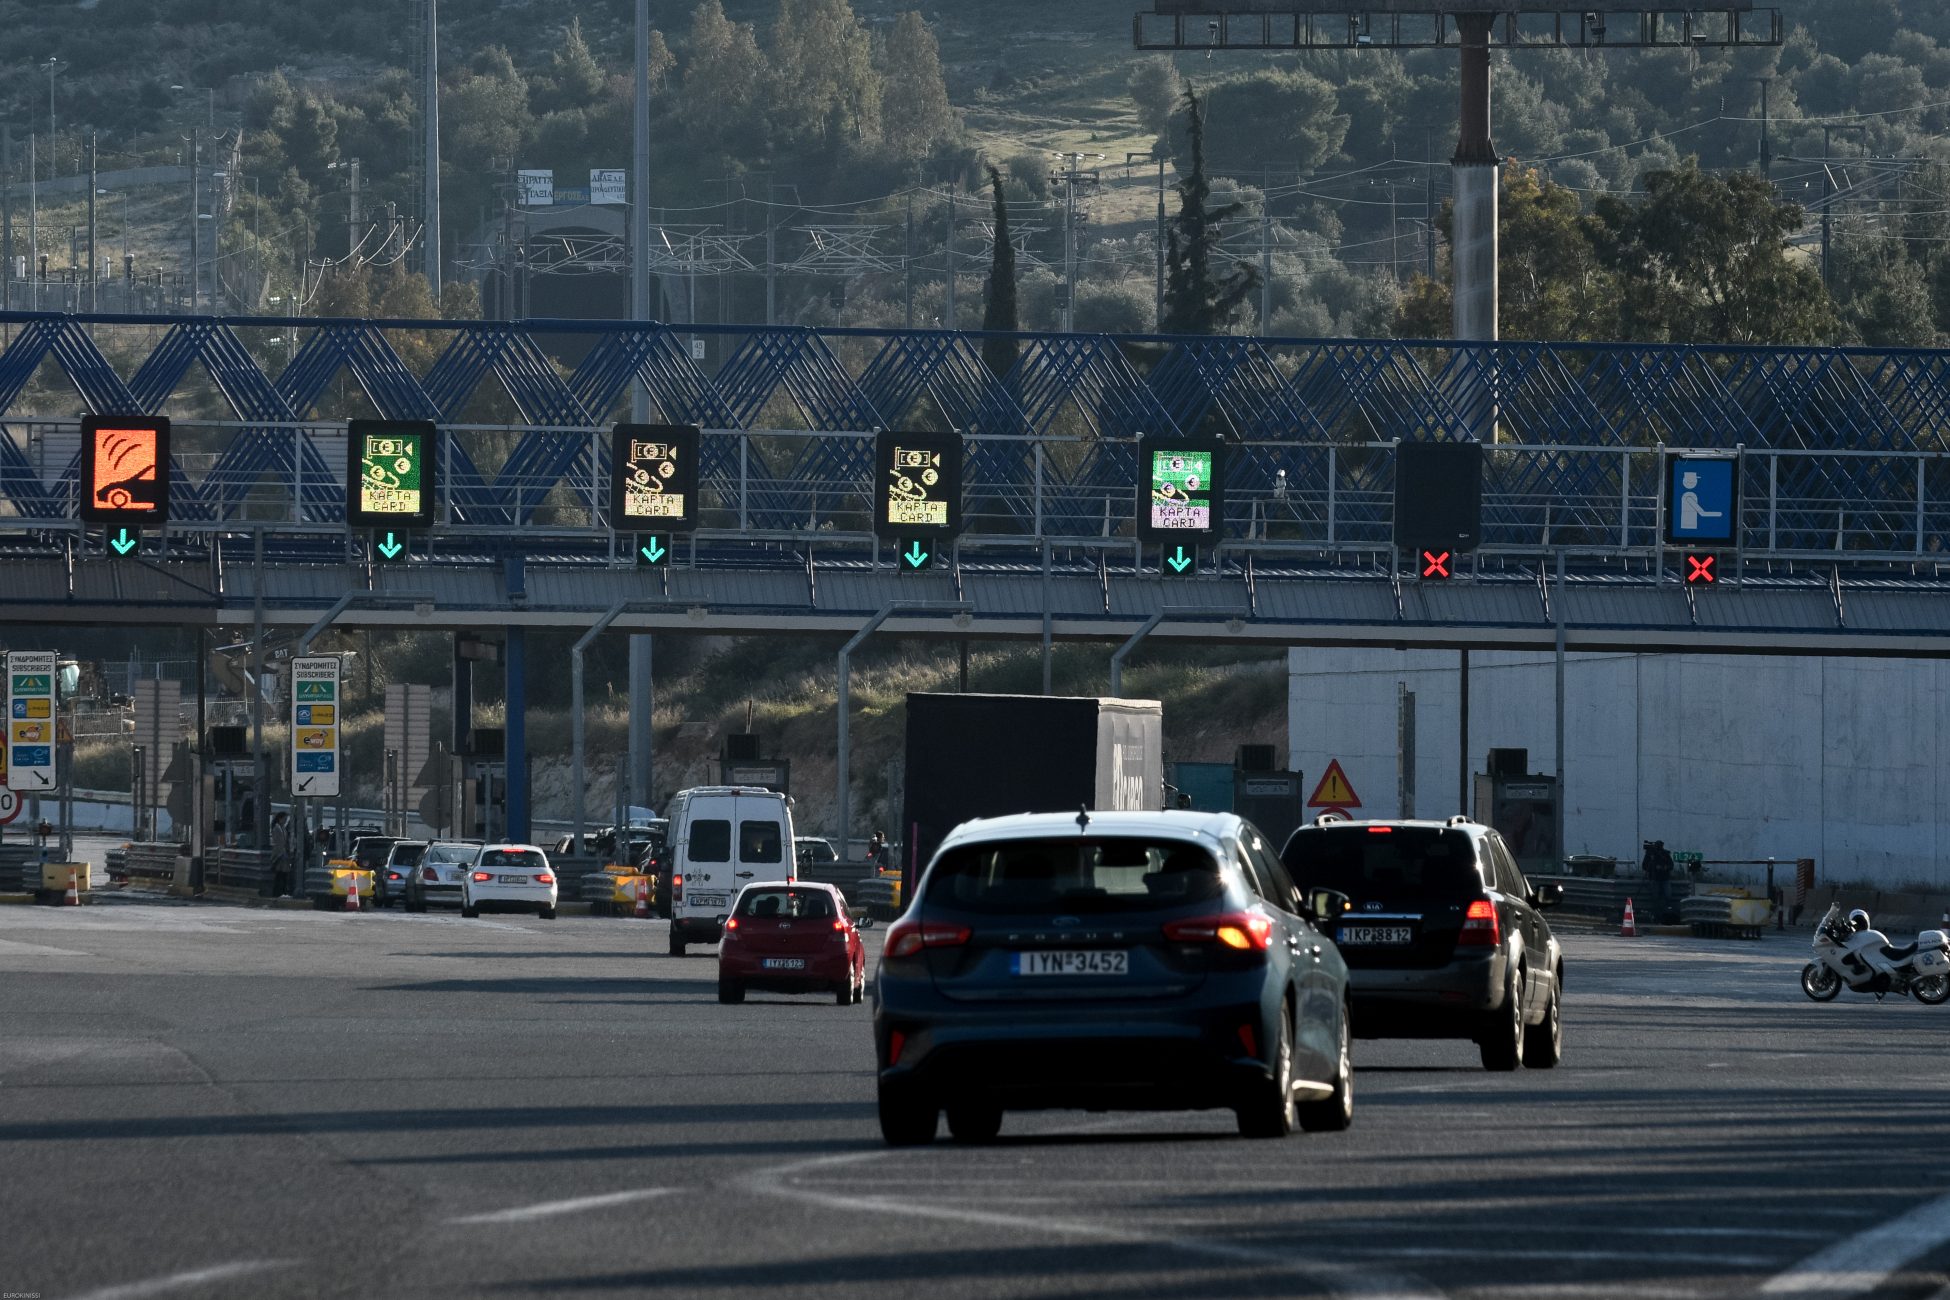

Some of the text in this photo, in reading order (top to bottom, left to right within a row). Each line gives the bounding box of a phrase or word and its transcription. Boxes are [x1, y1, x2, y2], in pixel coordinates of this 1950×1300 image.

[370, 491, 411, 500] ΚΑΡΤΑ
[633, 495, 674, 504] ΚΑΡΤΑ
[373, 502, 406, 511] CARD
[637, 505, 669, 515] CARD
[897, 502, 937, 511] ΚΑΡΤΑ
[1160, 508, 1200, 517] ΚΑΡΤΑ
[900, 513, 932, 522] CARD
[1163, 518, 1195, 528] CARD
[12, 664, 52, 672] SUBSCRIBERS
[294, 662, 337, 670] ΣΥΝΔΡΟΜΗΤΕΣ
[296, 671, 335, 679] SUBSCRIBERS
